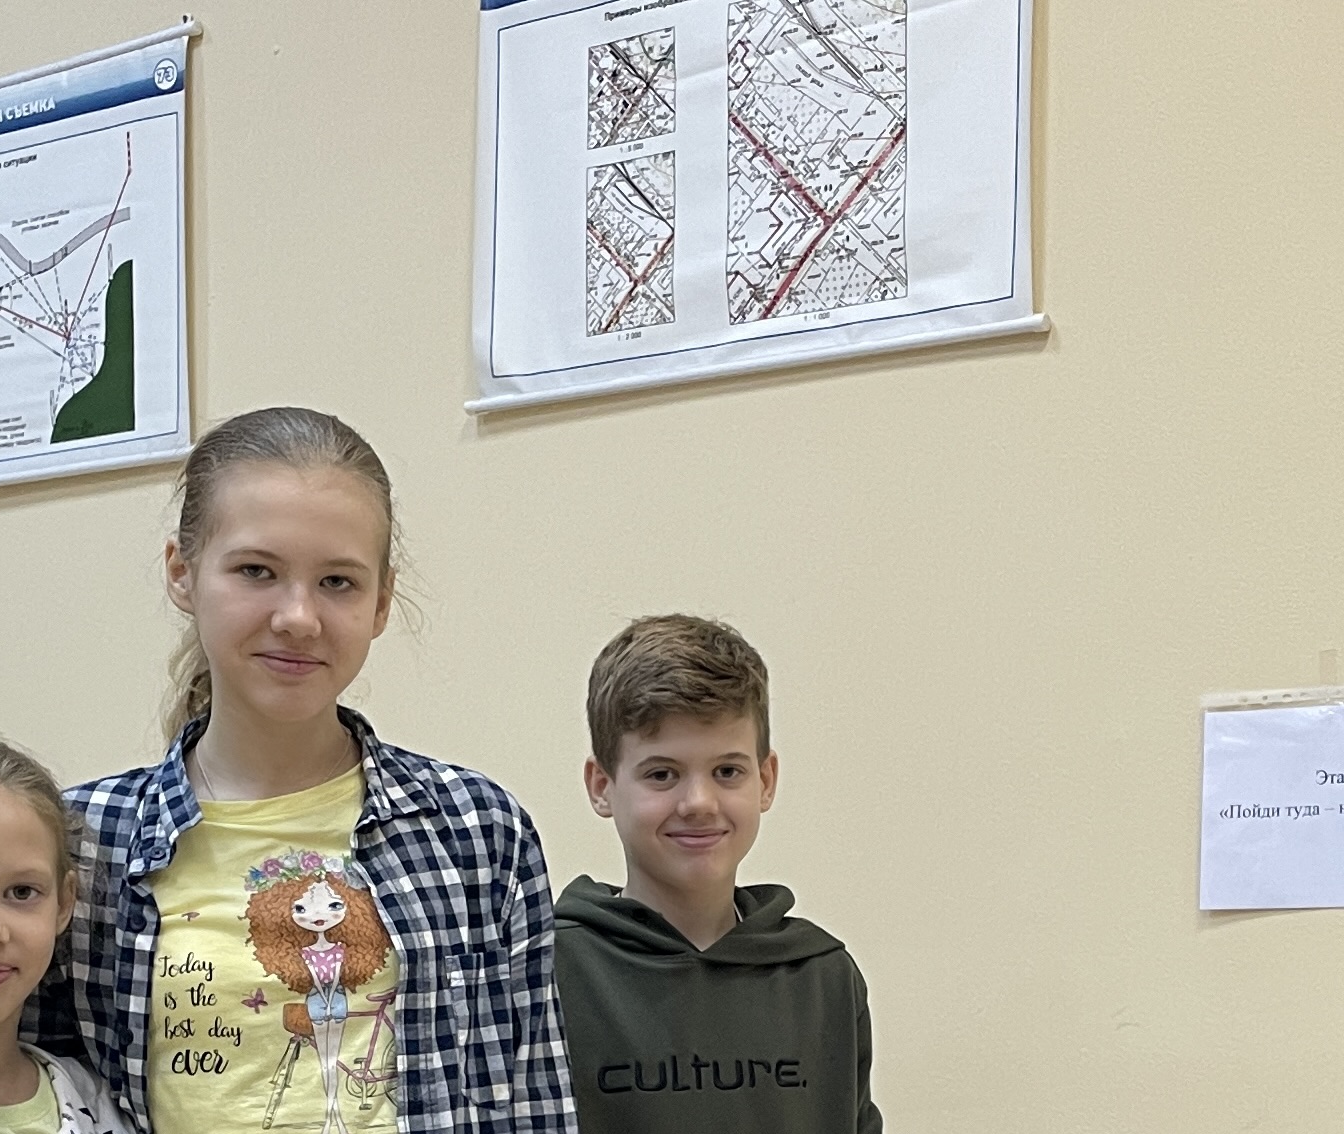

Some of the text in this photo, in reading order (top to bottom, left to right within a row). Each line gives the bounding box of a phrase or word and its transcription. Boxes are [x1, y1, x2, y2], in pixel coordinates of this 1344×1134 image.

[156, 66, 174, 84] 73
[5, 96, 56, 121] СЪЕМКА
[1219, 803, 1281, 819] «Пойди
[1285, 804, 1320, 820] туда
[158, 951, 216, 981] Today
[164, 982, 218, 1010] is the
[164, 1016, 243, 1047] best day
[171, 1049, 229, 1076] ever
